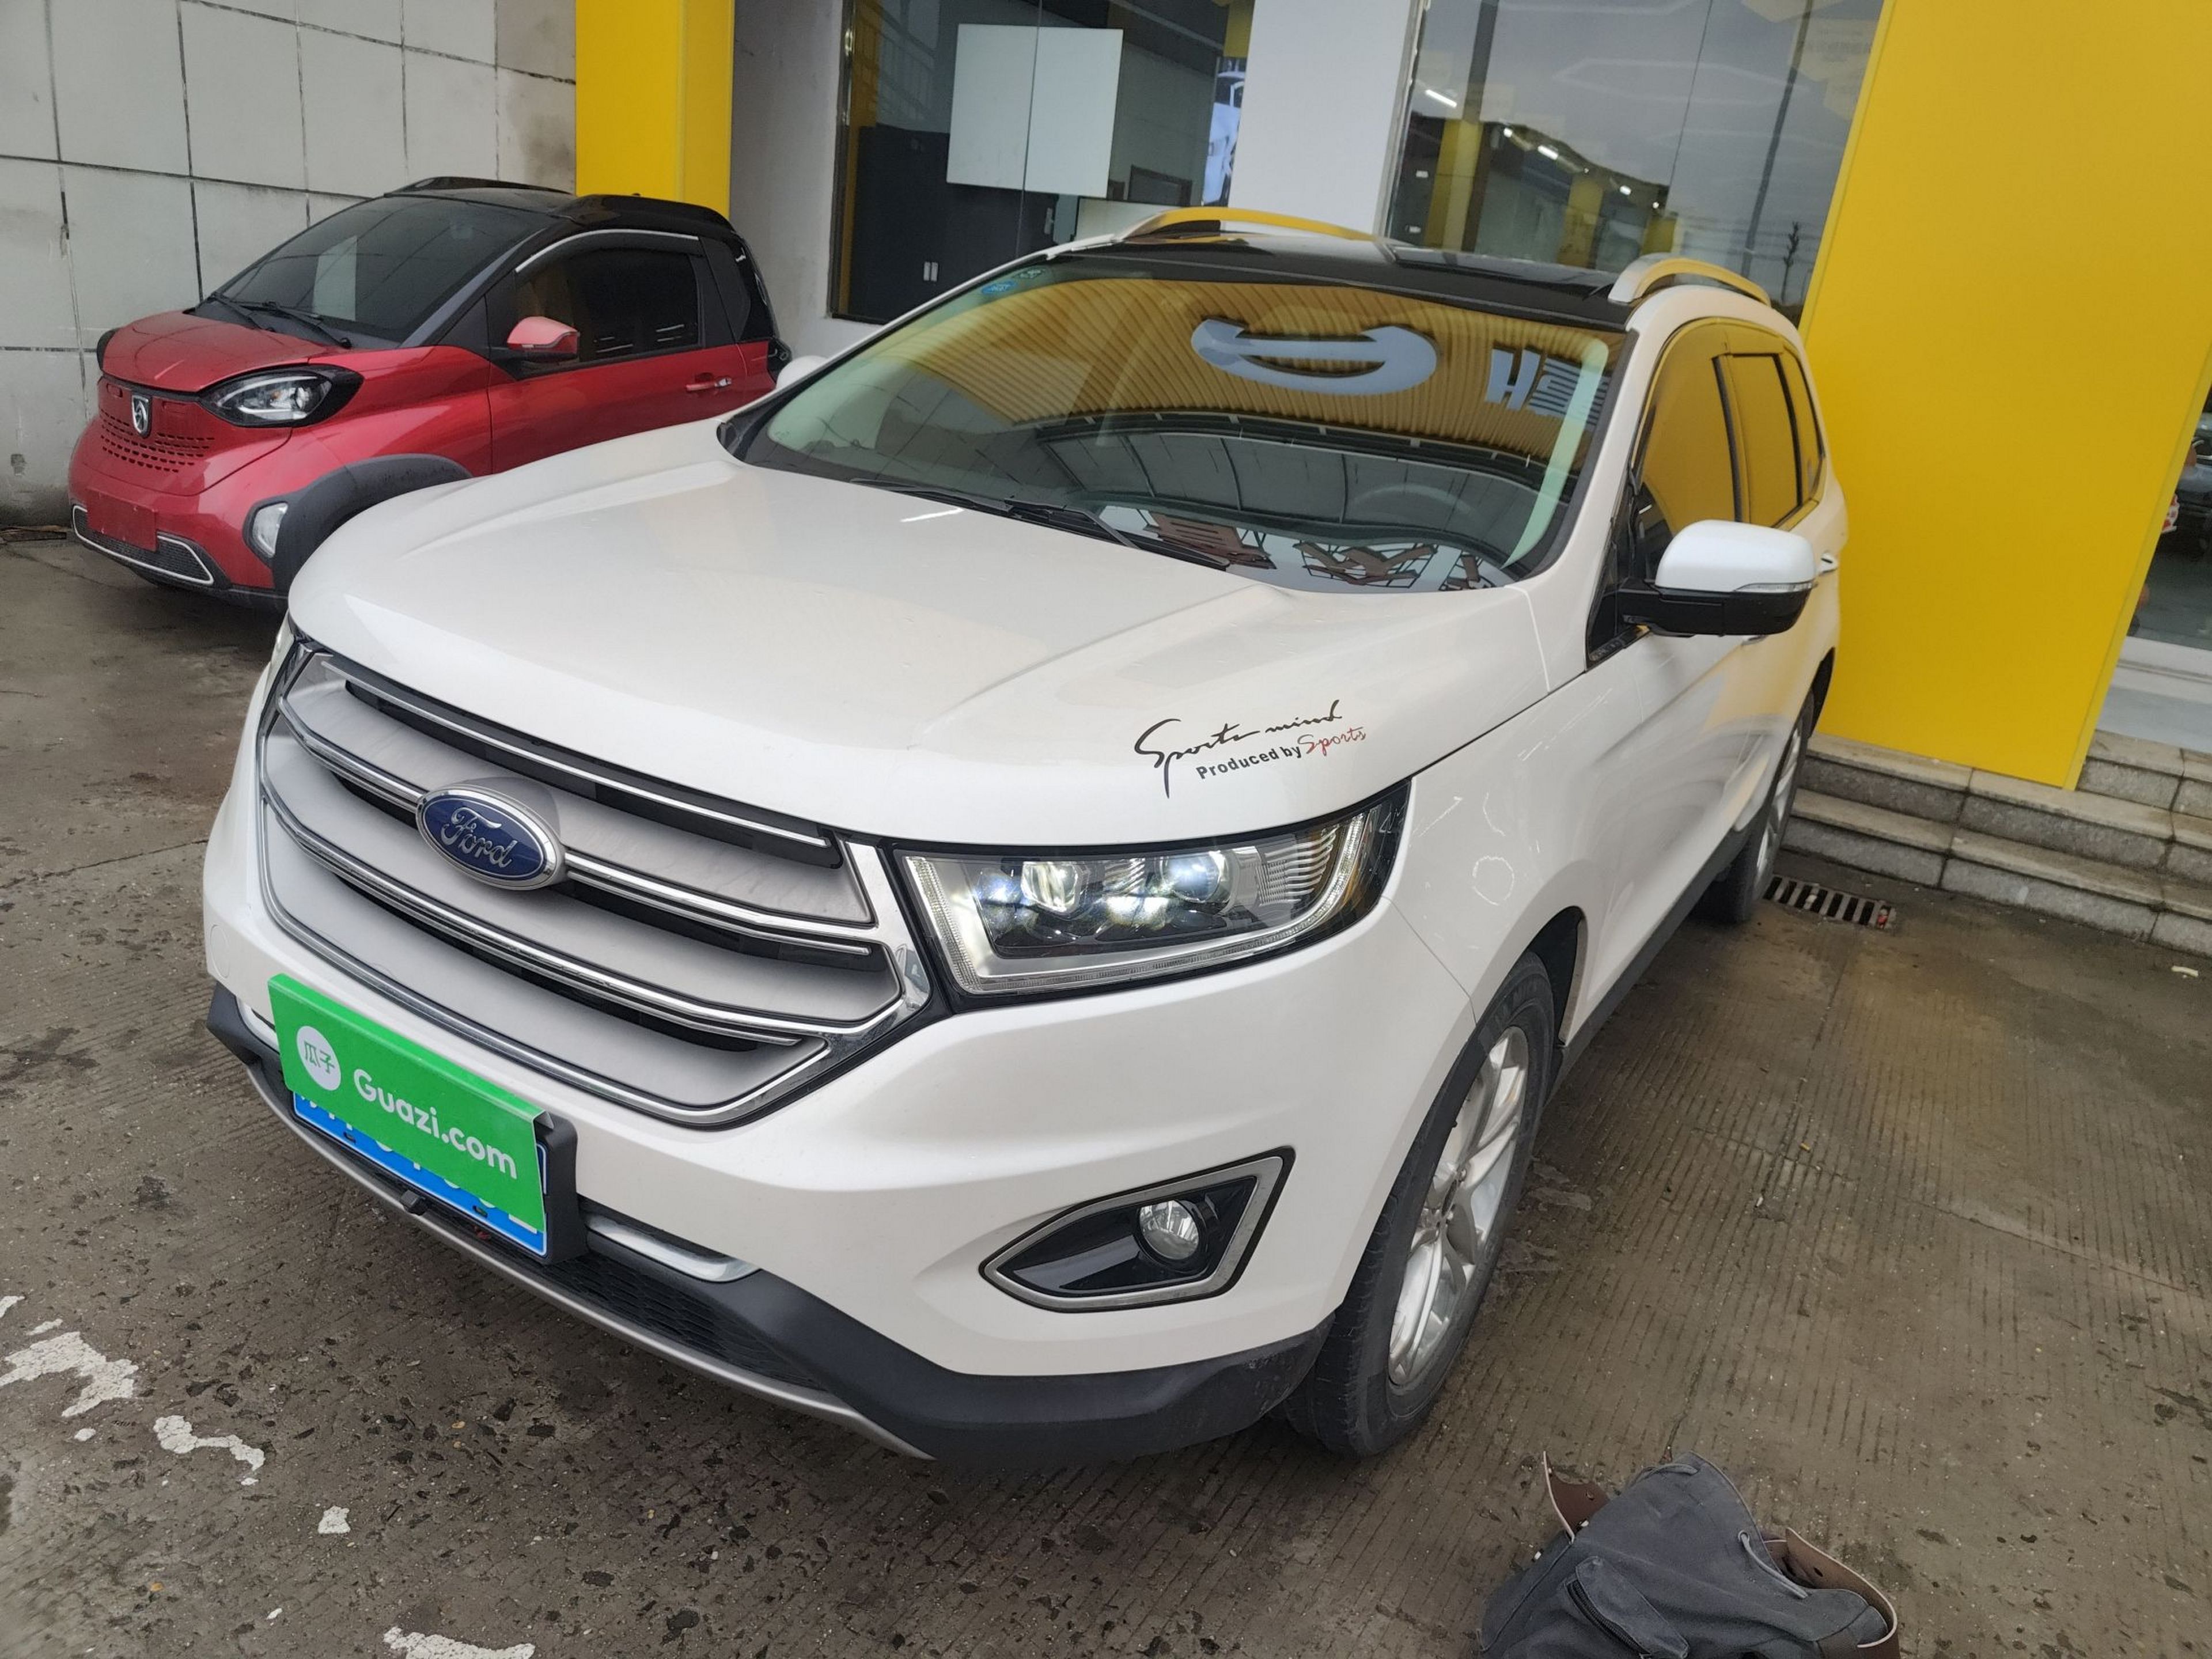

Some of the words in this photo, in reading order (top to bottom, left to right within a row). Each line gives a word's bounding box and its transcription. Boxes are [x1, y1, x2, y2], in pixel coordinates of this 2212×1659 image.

[1264, 699, 1343, 733] mind
[1195, 748, 1279, 779] Produced
[1279, 746, 1302, 759] by
[1297, 726, 1366, 757] Sports
[441, 806, 518, 868] Ford
[304, 1041, 335, 1074] 瓜子
[353, 1068, 518, 1180] Guazi.com
